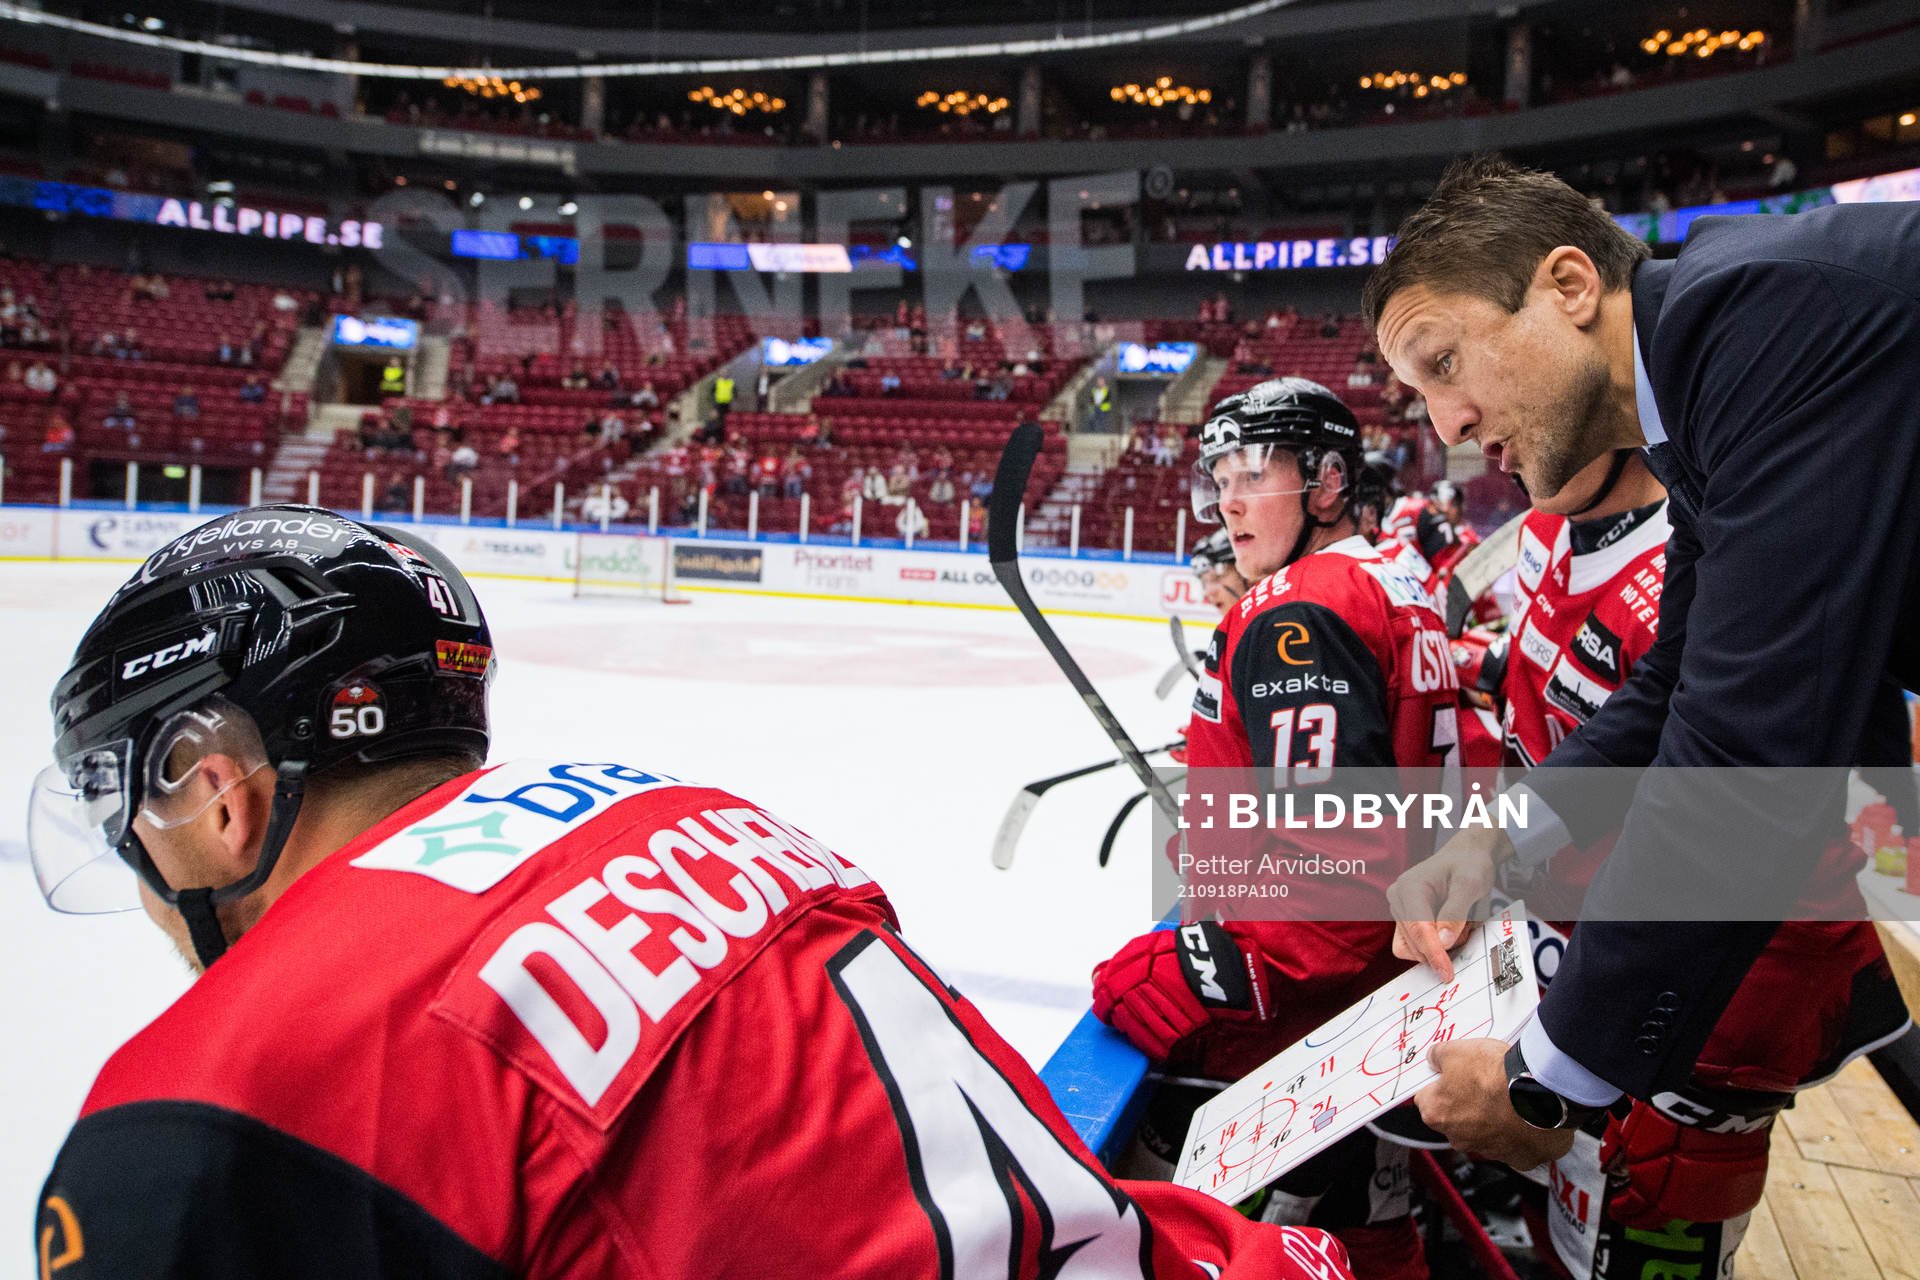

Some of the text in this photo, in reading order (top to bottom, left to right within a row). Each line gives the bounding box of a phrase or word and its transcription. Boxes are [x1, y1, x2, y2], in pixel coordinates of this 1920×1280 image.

[156, 197, 383, 250] ALLPIPE.SE
[365, 170, 1146, 356] SERNEKE
[1323, 420, 1355, 438] CCM
[172, 516, 351, 558] kjellander
[223, 539, 299, 554] VVS AB
[974, 572, 999, 585] OU
[1619, 583, 1660, 635] HOTEL
[122, 630, 217, 681] CCM
[1575, 622, 1616, 672] RSA
[1252, 672, 1350, 698] exakta
[330, 704, 386, 740] 50
[1269, 702, 1338, 789] 13
[1500, 909, 1514, 937] CCM
[1180, 921, 1228, 1003] CM
[1432, 1023, 1456, 1043] 41
[1320, 1055, 1335, 1078] 11
[1651, 1090, 1775, 1135] CM
[1219, 1121, 1238, 1146] 14
